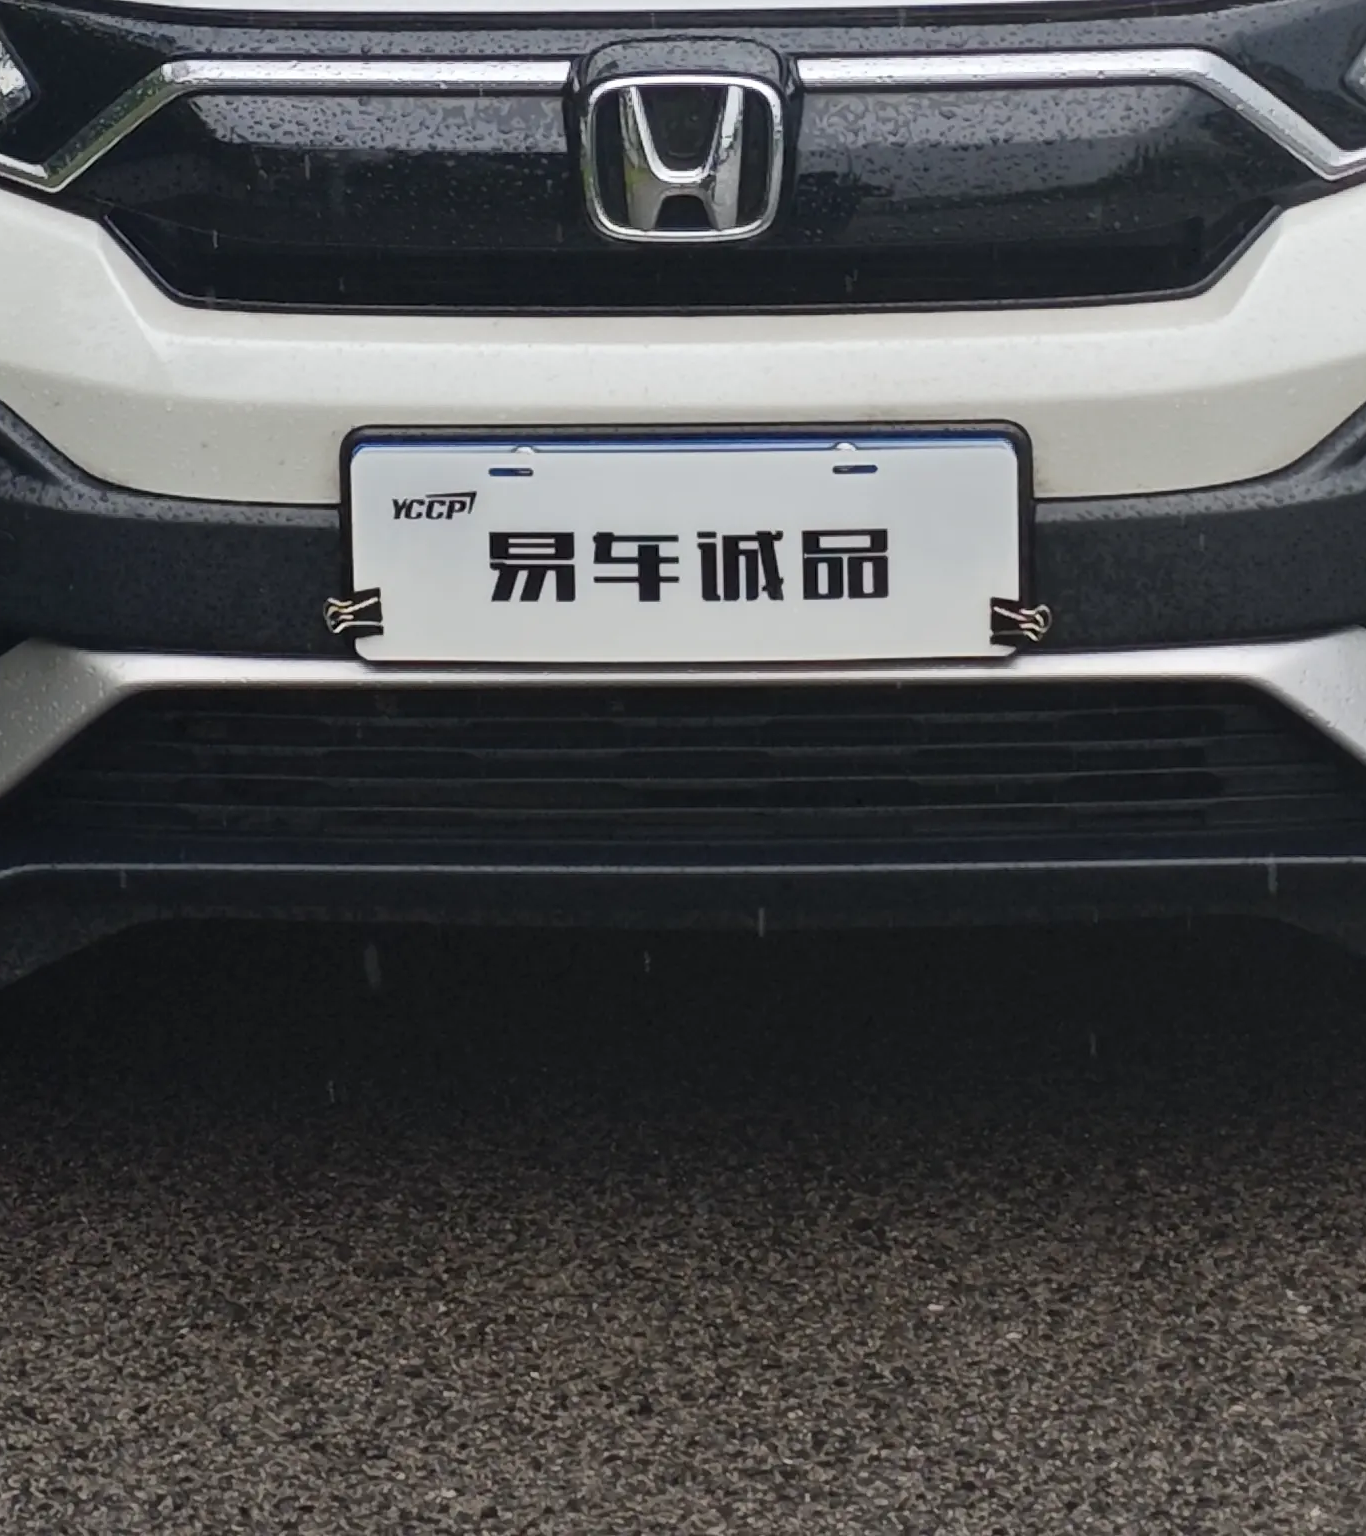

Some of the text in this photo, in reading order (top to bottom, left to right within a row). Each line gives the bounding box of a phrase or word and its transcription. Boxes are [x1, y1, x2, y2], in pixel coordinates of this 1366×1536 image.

[391, 491, 477, 520] YCCP
[489, 528, 889, 602] 易车诚品
